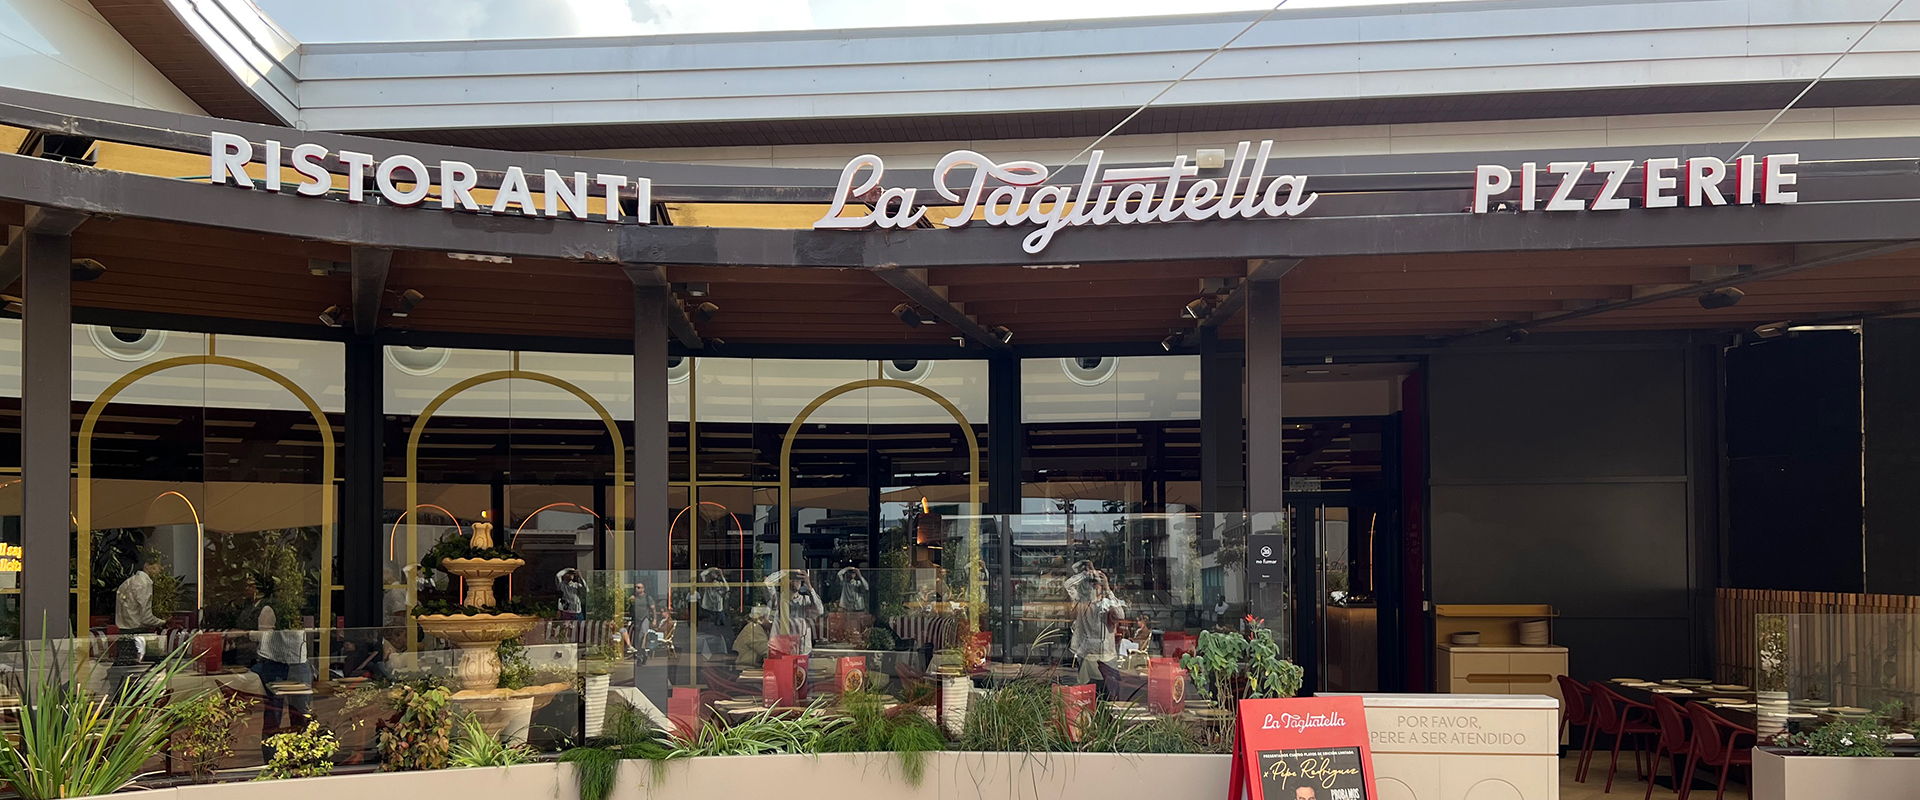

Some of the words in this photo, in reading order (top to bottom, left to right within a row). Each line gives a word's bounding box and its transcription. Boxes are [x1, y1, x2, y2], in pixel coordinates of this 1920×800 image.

[211, 131, 652, 225] RISTORANTI
[1473, 153, 1799, 214] PIZZERIE
[813, 153, 928, 229] La
[932, 140, 1318, 254] Tagliatella
[1261, 713, 1281, 730] La
[1281, 711, 1346, 734] Tagliatella
[1397, 715, 1429, 728] POR
[1431, 716, 1482, 730] FAVOR,
[1368, 731, 1406, 744] PERE
[1408, 732, 1419, 744] A
[1421, 732, 1447, 744] SER
[1450, 732, 1526, 746] ATENDIDO
[1269, 760, 1297, 791] Pepe
